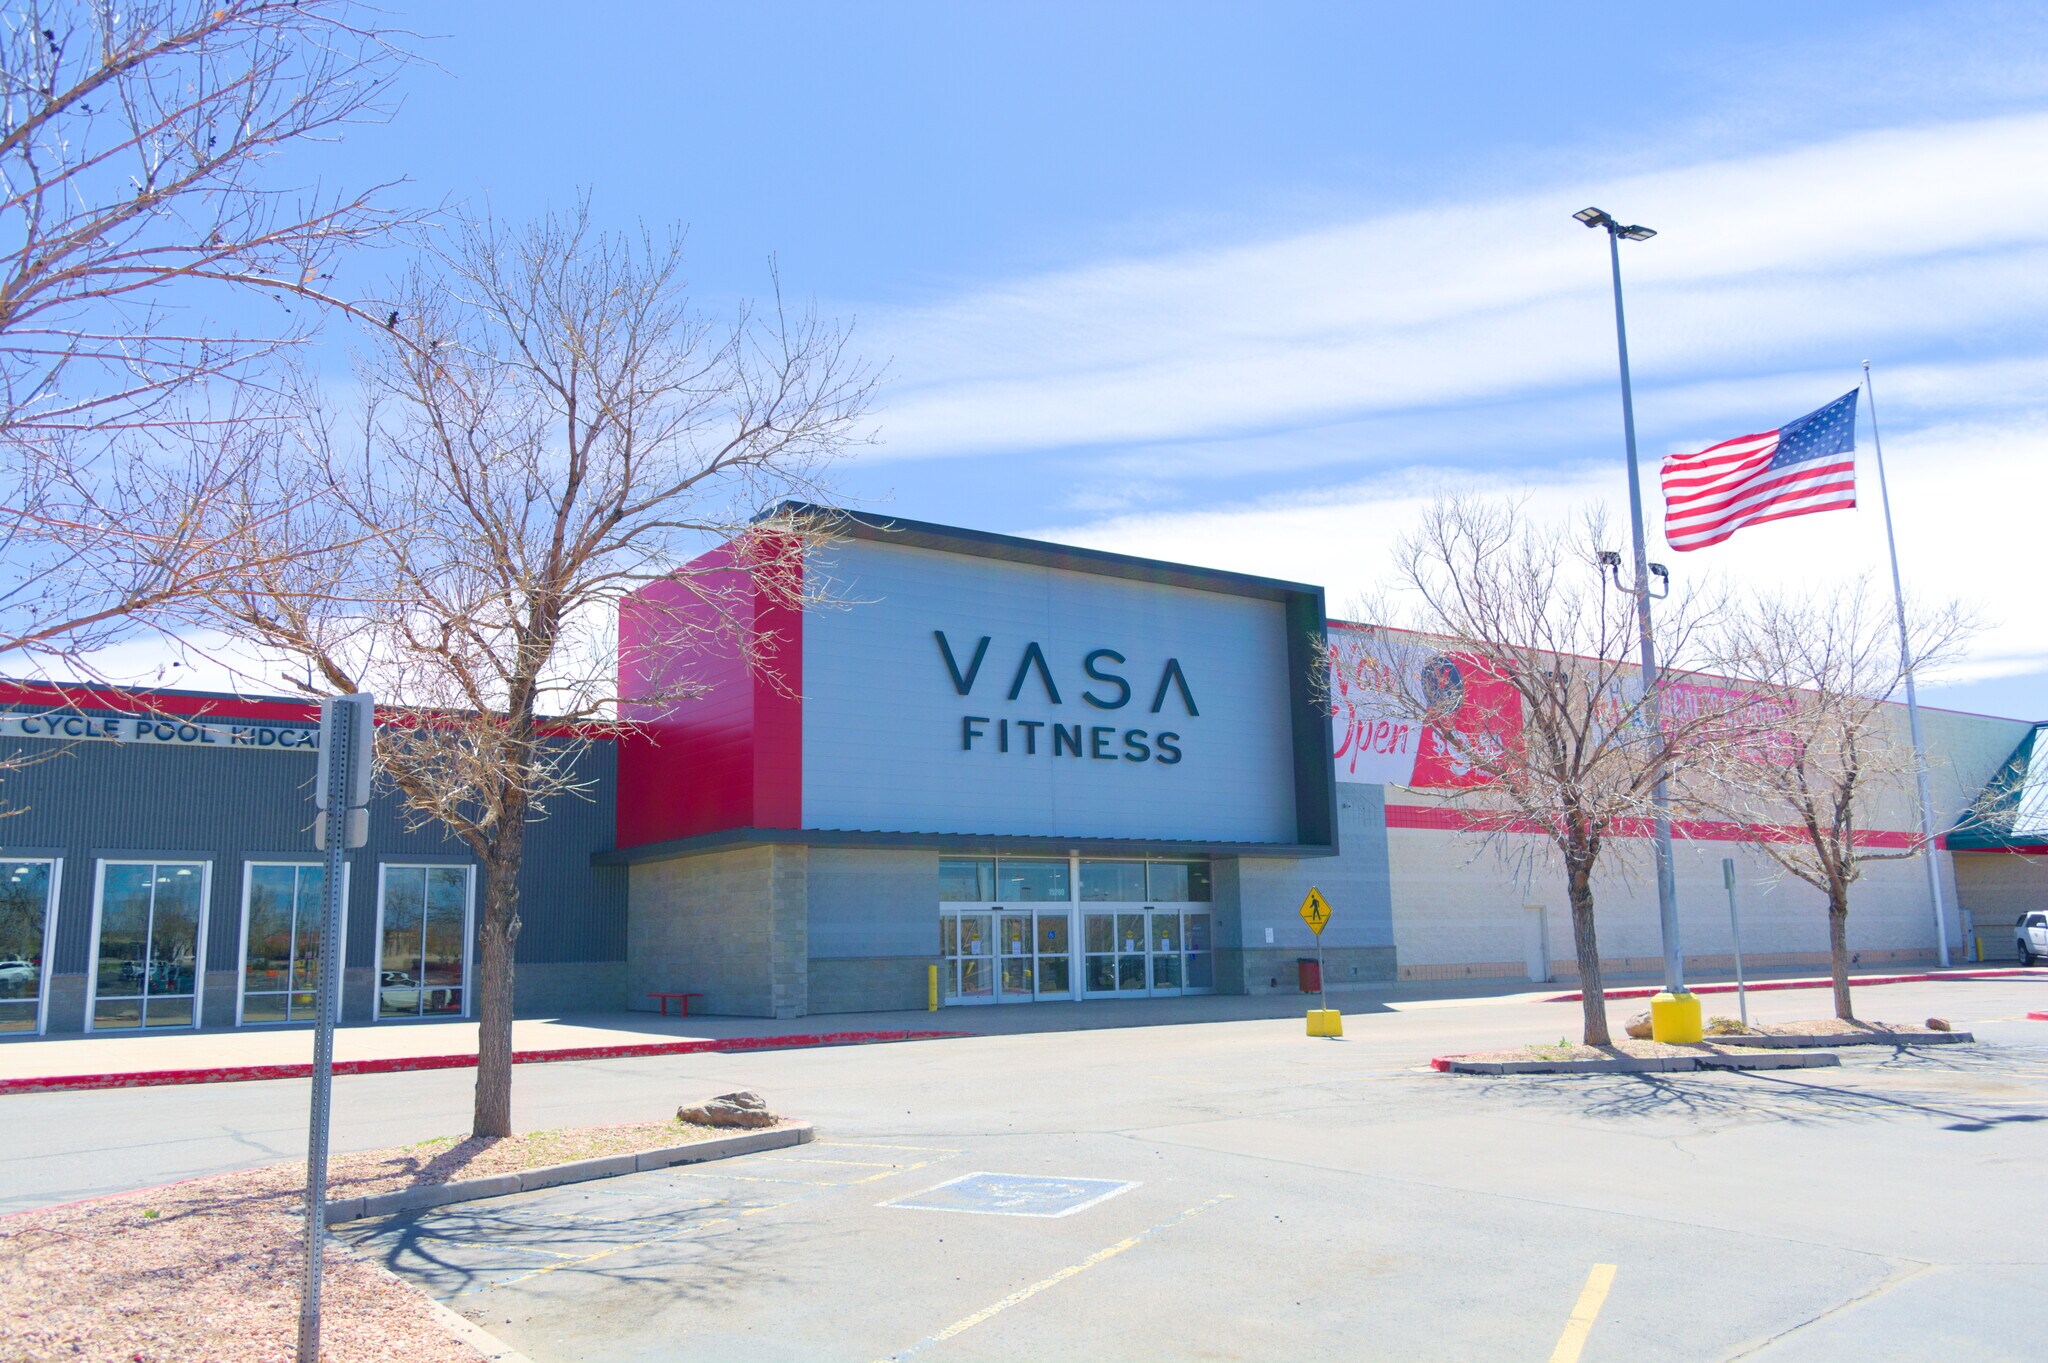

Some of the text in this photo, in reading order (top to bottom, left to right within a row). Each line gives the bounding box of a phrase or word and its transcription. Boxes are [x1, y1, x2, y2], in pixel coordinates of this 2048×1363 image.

[934, 630, 1200, 717] VASA
[21, 715, 120, 739] CYCLE
[136, 721, 215, 744] POOL
[231, 726, 320, 748] KIDCA
[963, 715, 1182, 765] FITNESS
